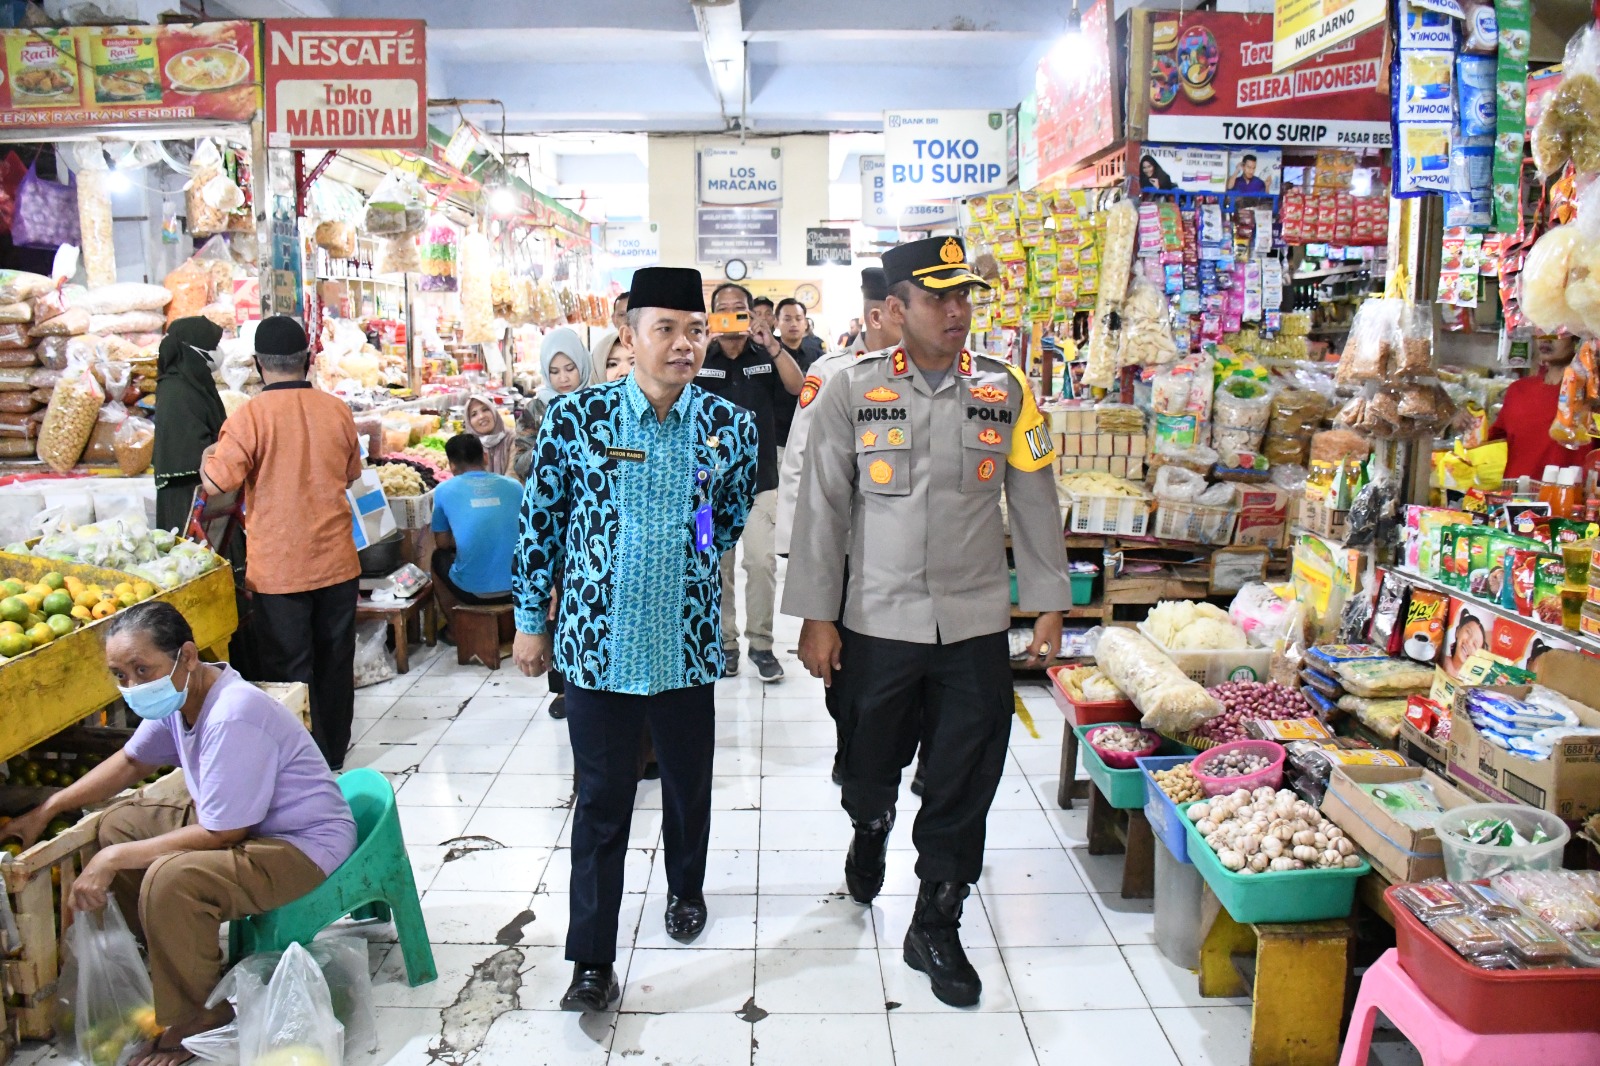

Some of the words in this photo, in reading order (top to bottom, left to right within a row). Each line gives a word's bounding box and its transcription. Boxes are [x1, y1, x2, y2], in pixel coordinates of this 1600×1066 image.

[1295, 29, 1315, 50] NUR
[1319, 8, 1355, 38] JARNO
[20, 48, 60, 63] Racik
[110, 47, 137, 58] Racik
[271, 30, 416, 67] NESCAFÉ
[1240, 43, 1273, 67] Teru
[1297, 62, 1377, 94] INDONESIA
[323, 83, 372, 106] Toko
[1239, 76, 1292, 103] SELERA
[53, 110, 124, 122] RACIKAN
[129, 106, 194, 119] SENDIRI
[1222, 122, 1271, 141] TOKO
[1276, 124, 1327, 142] SURIP
[1337, 132, 1370, 143] PASAR
[1372, 133, 1393, 145] BES
[913, 139, 979, 159] TOKO
[1140, 148, 1178, 158] PANTENE
[729, 167, 756, 178] LOS
[892, 164, 924, 183] BU
[931, 163, 1001, 184] SURIP
[708, 179, 777, 191] MRACANG
[617, 239, 641, 248] TOKO
[857, 407, 907, 422] AGUS.DS
[967, 406, 1012, 425] POLRI
